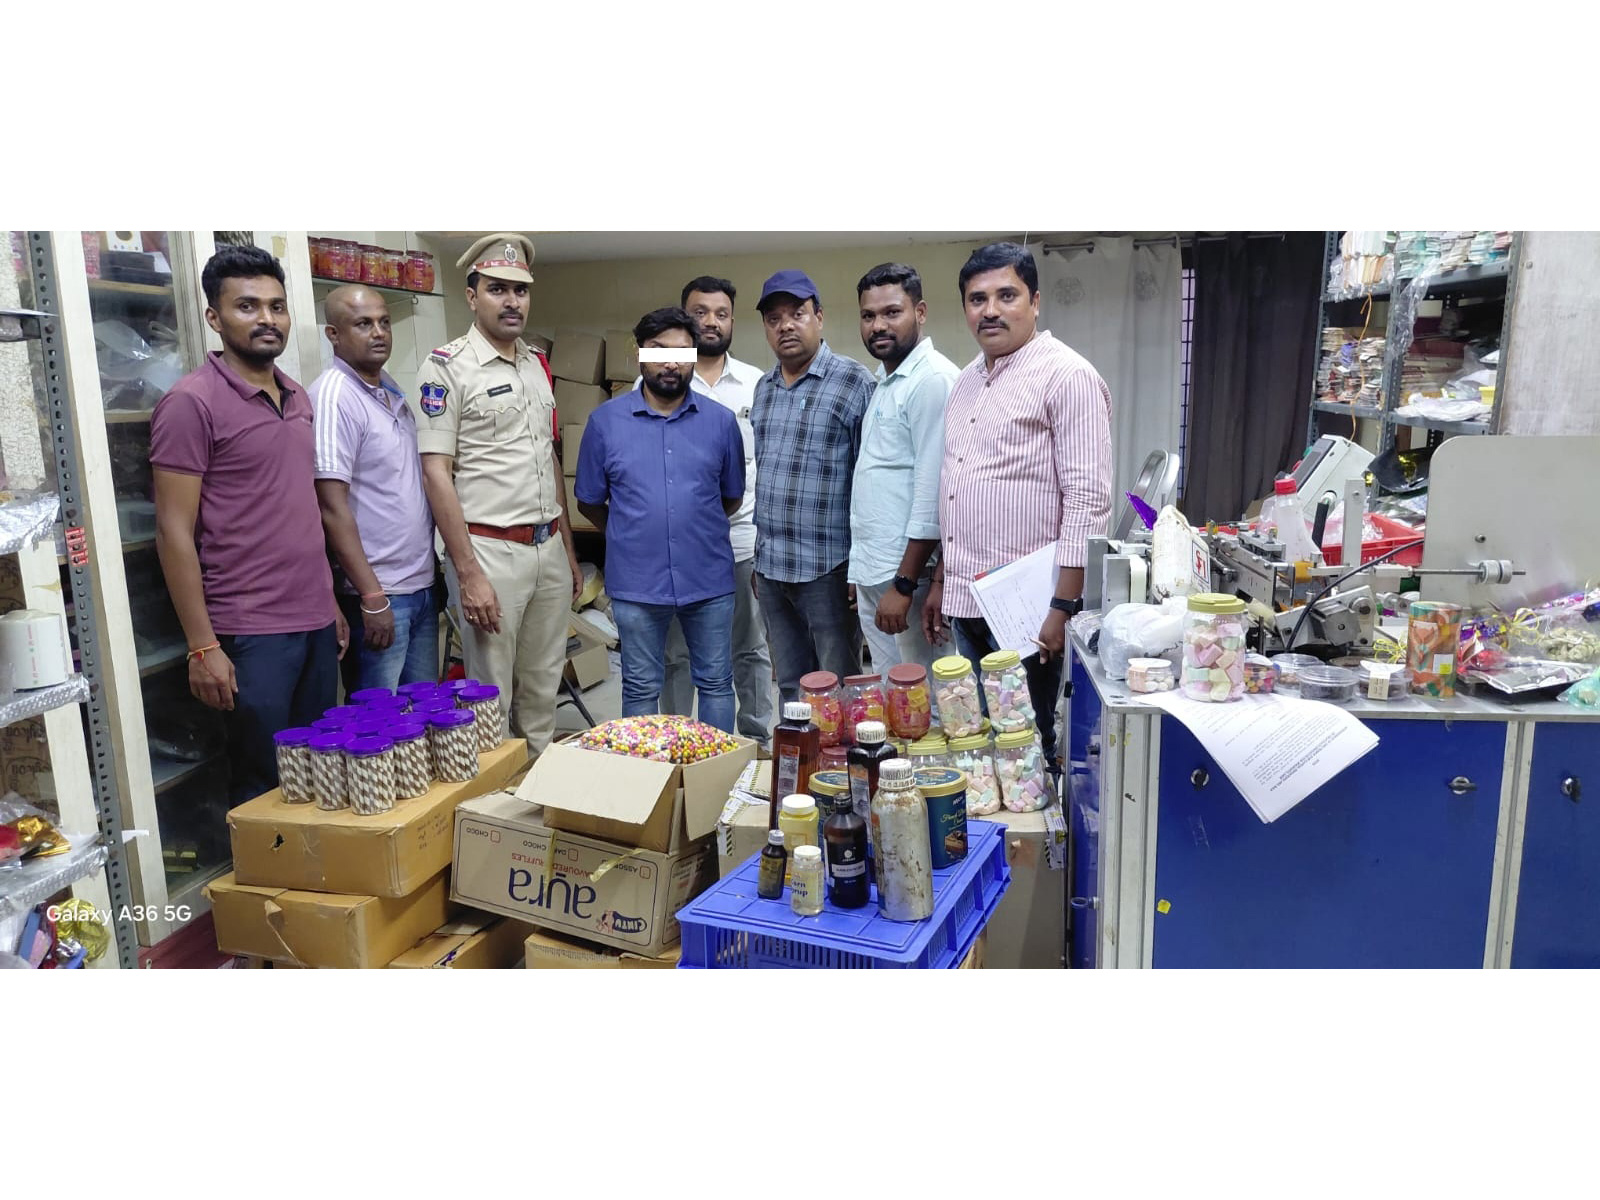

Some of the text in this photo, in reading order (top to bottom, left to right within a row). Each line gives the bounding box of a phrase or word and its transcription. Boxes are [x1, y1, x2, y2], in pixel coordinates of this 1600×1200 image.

[466, 827, 489, 838] CHOCO
[522, 840, 547, 851] CHOCO
[511, 852, 545, 867] RUFFLES
